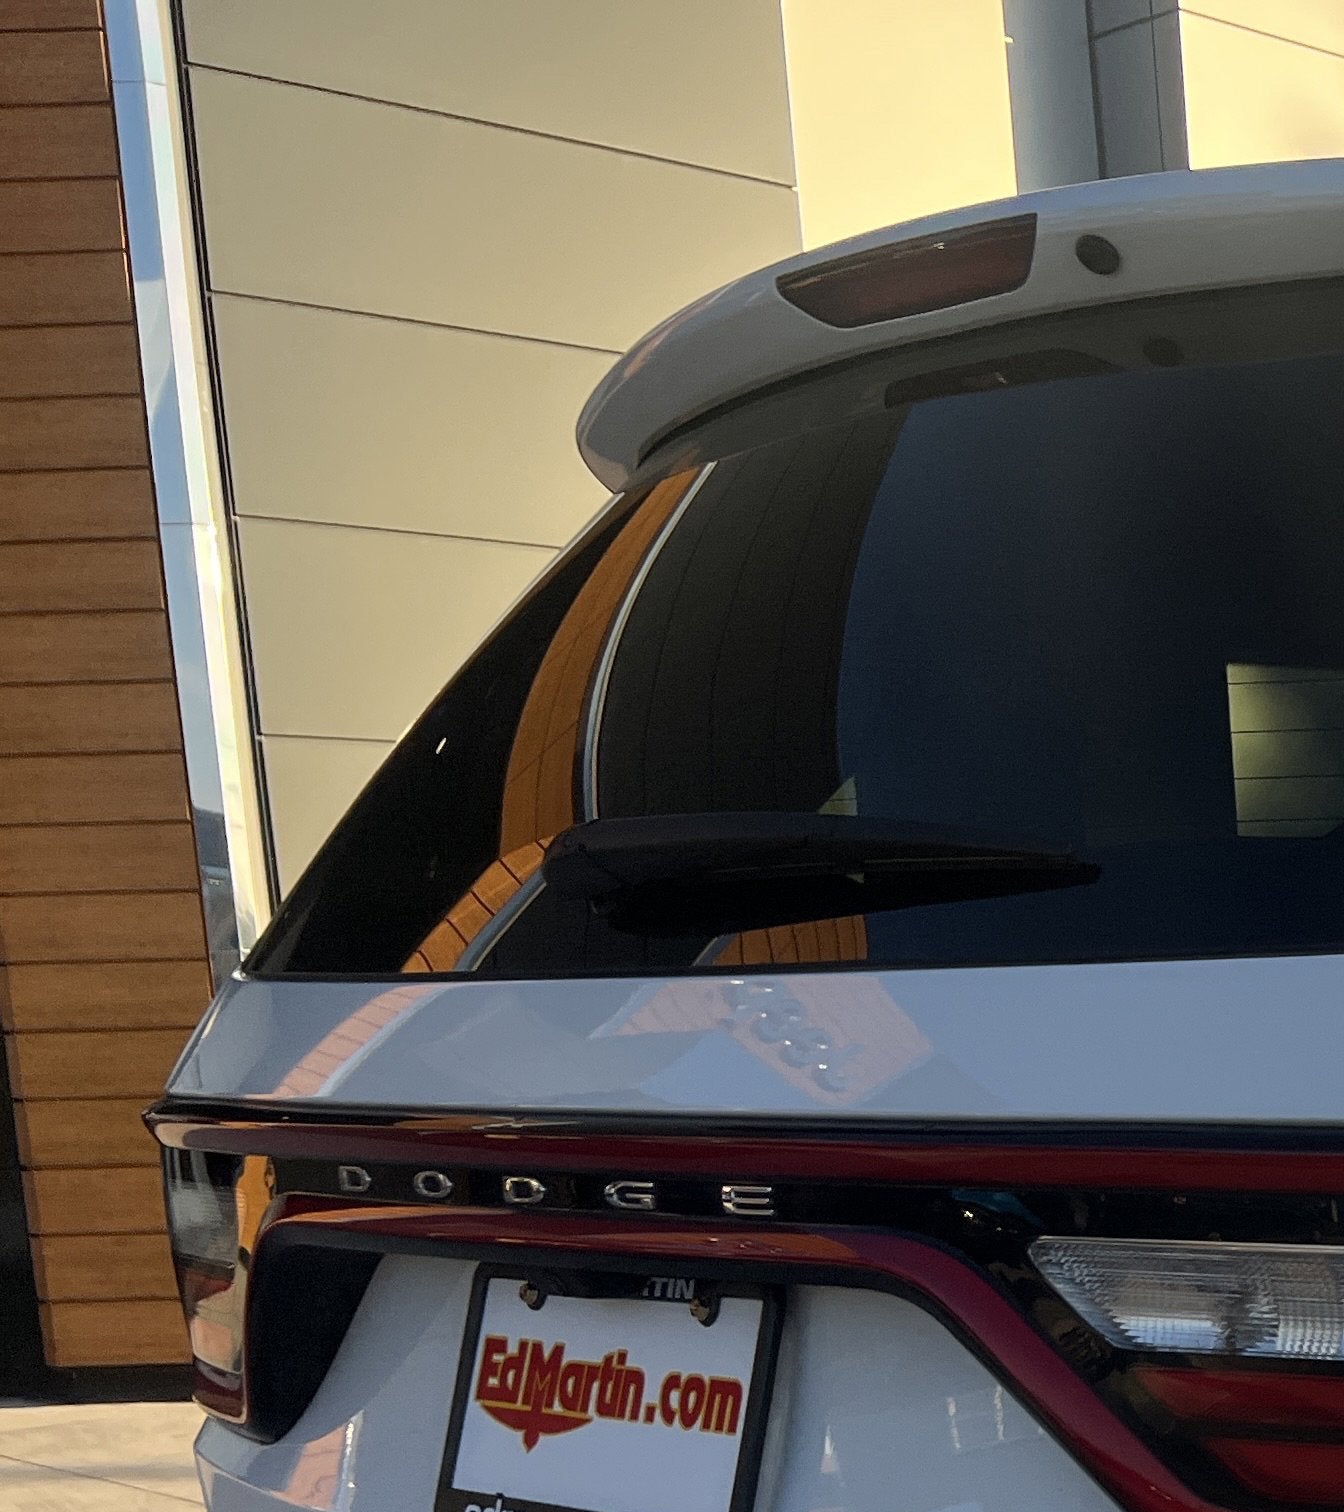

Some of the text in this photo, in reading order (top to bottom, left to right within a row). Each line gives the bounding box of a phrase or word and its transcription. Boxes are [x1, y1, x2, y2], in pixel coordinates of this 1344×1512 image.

[338, 1165, 776, 1216] DODGE
[641, 1276, 696, 1300] TIN
[474, 1334, 744, 1437] EdMartin.com
